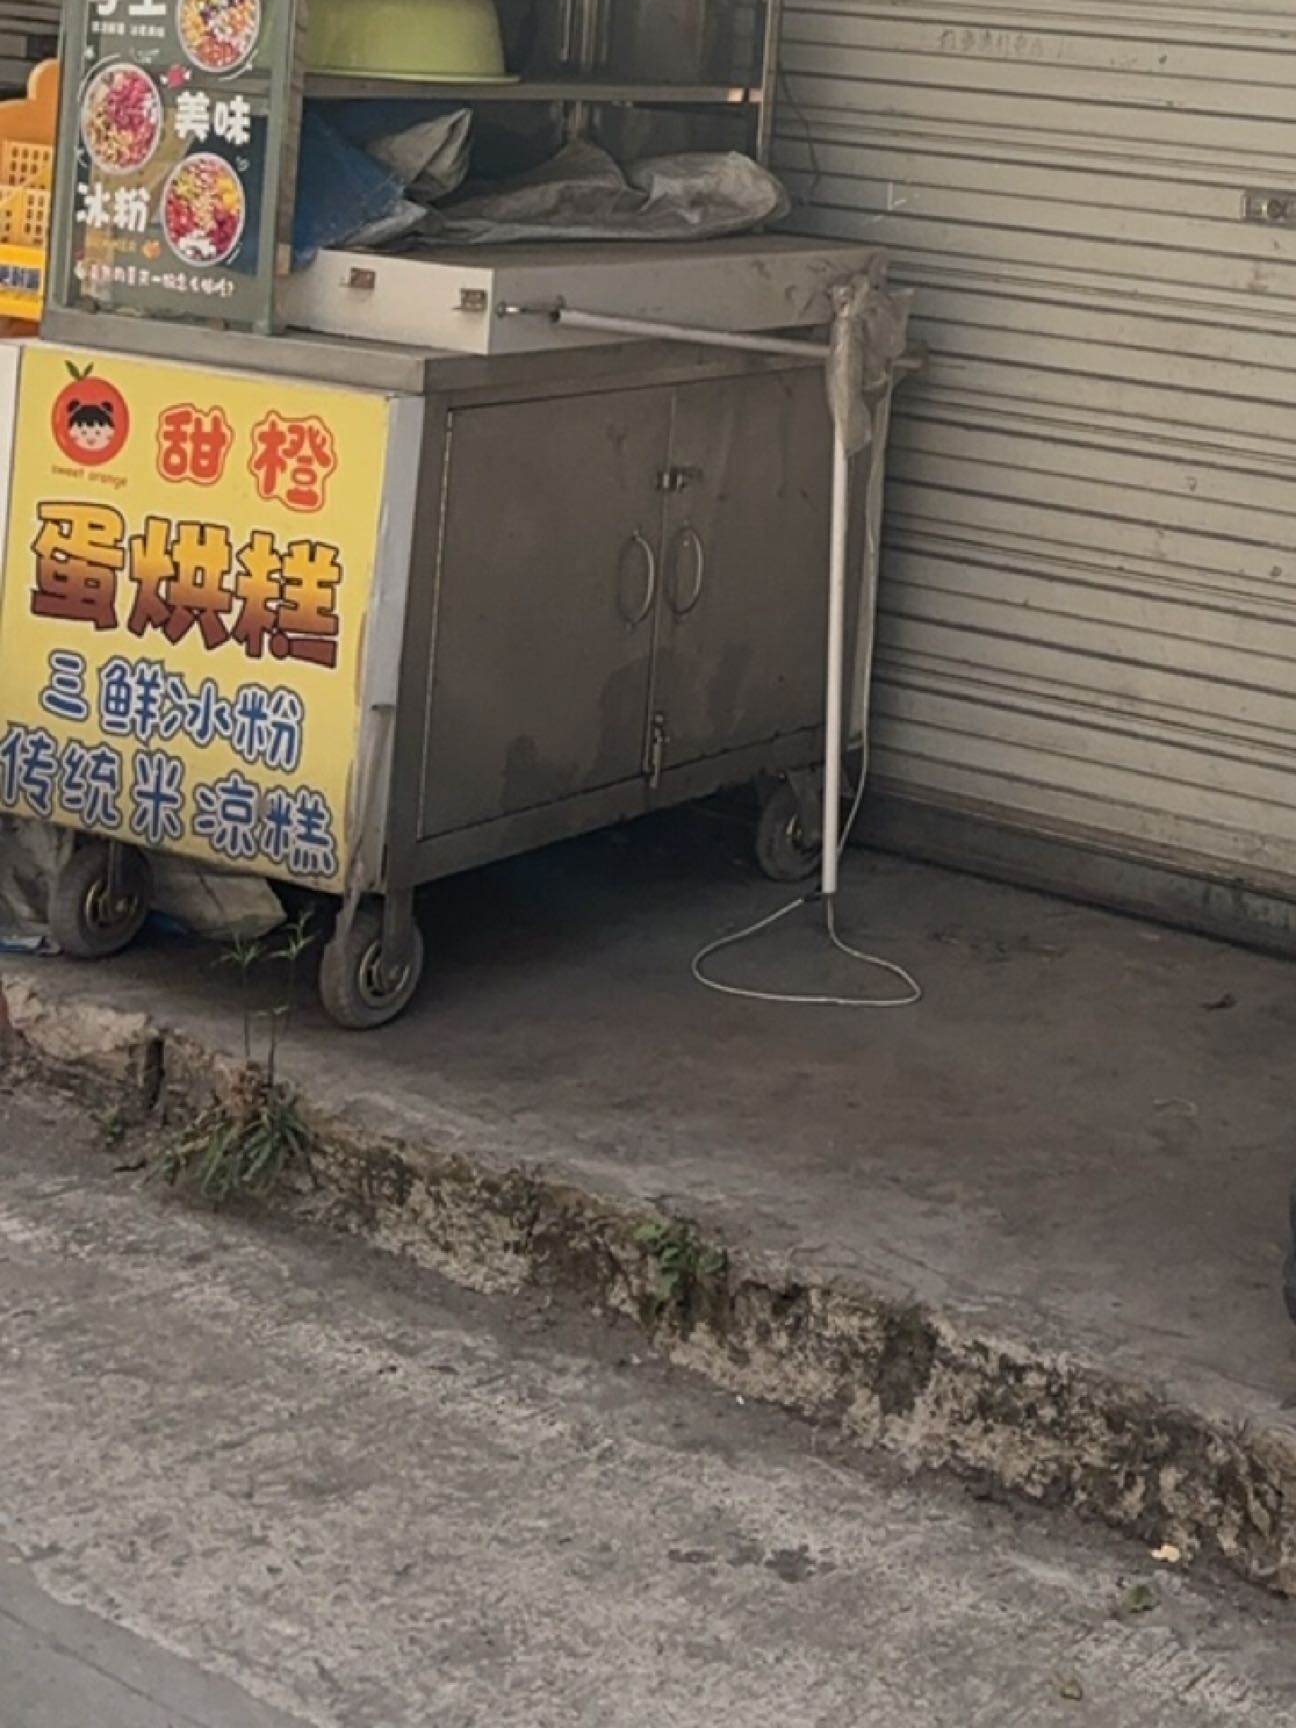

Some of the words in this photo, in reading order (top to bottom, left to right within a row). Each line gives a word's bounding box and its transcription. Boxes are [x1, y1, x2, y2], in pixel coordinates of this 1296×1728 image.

[173, 90, 252, 147] 美味
[75, 181, 150, 234] 冰粉
[158, 404, 338, 511] 甜橙
[31, 501, 344, 669] 蛋烘糕
[38, 649, 306, 772] 三鲜冰粉
[0, 725, 338, 876] 传统米凉糕
